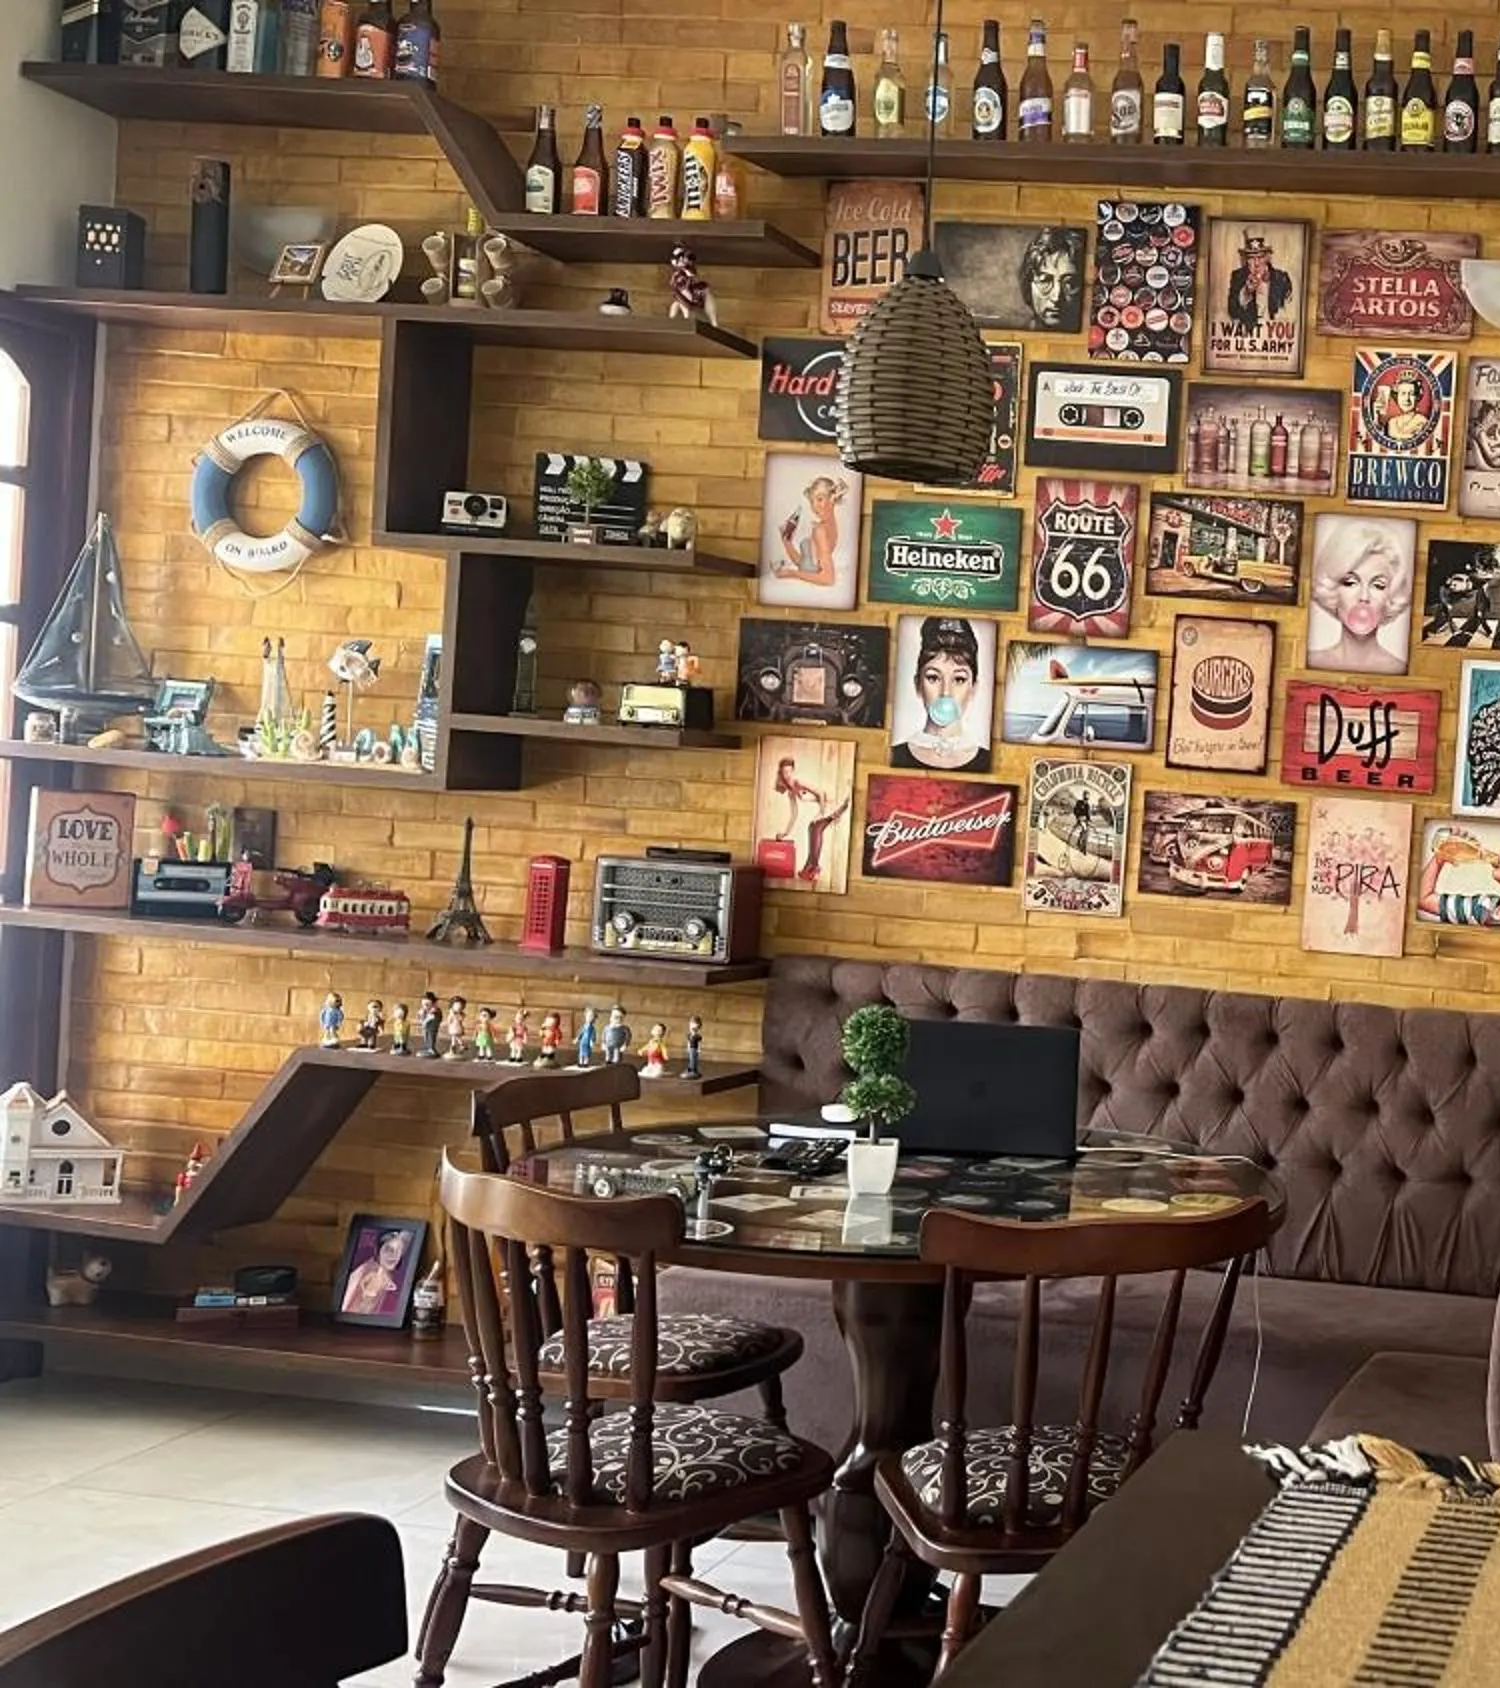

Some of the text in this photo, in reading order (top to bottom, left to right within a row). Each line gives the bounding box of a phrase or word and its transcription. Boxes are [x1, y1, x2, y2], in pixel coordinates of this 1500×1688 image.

[834, 197, 912, 227] Ice Cold
[831, 227, 911, 288] BEER
[1352, 276, 1440, 297] STELLA
[1350, 298, 1440, 318] ARTOIS
[1211, 321, 1295, 339] I WANT YOU
[1211, 339, 1231, 351] FOR
[768, 363, 834, 396] Hard
[226, 424, 287, 444] WELCOME
[1352, 457, 1442, 489] BREWCO
[1054, 511, 1115, 534] ROUTE
[892, 545, 997, 571] Heineken
[1051, 543, 1111, 601] 66
[1195, 658, 1252, 699] BURGERS
[1318, 693, 1399, 769] Duff
[1302, 767, 1414, 788] BEER
[58, 819, 113, 841] LOVE
[866, 810, 1013, 849] Budweiser
[51, 849, 114, 868] WHOLE
[1335, 863, 1400, 901] PIRA
